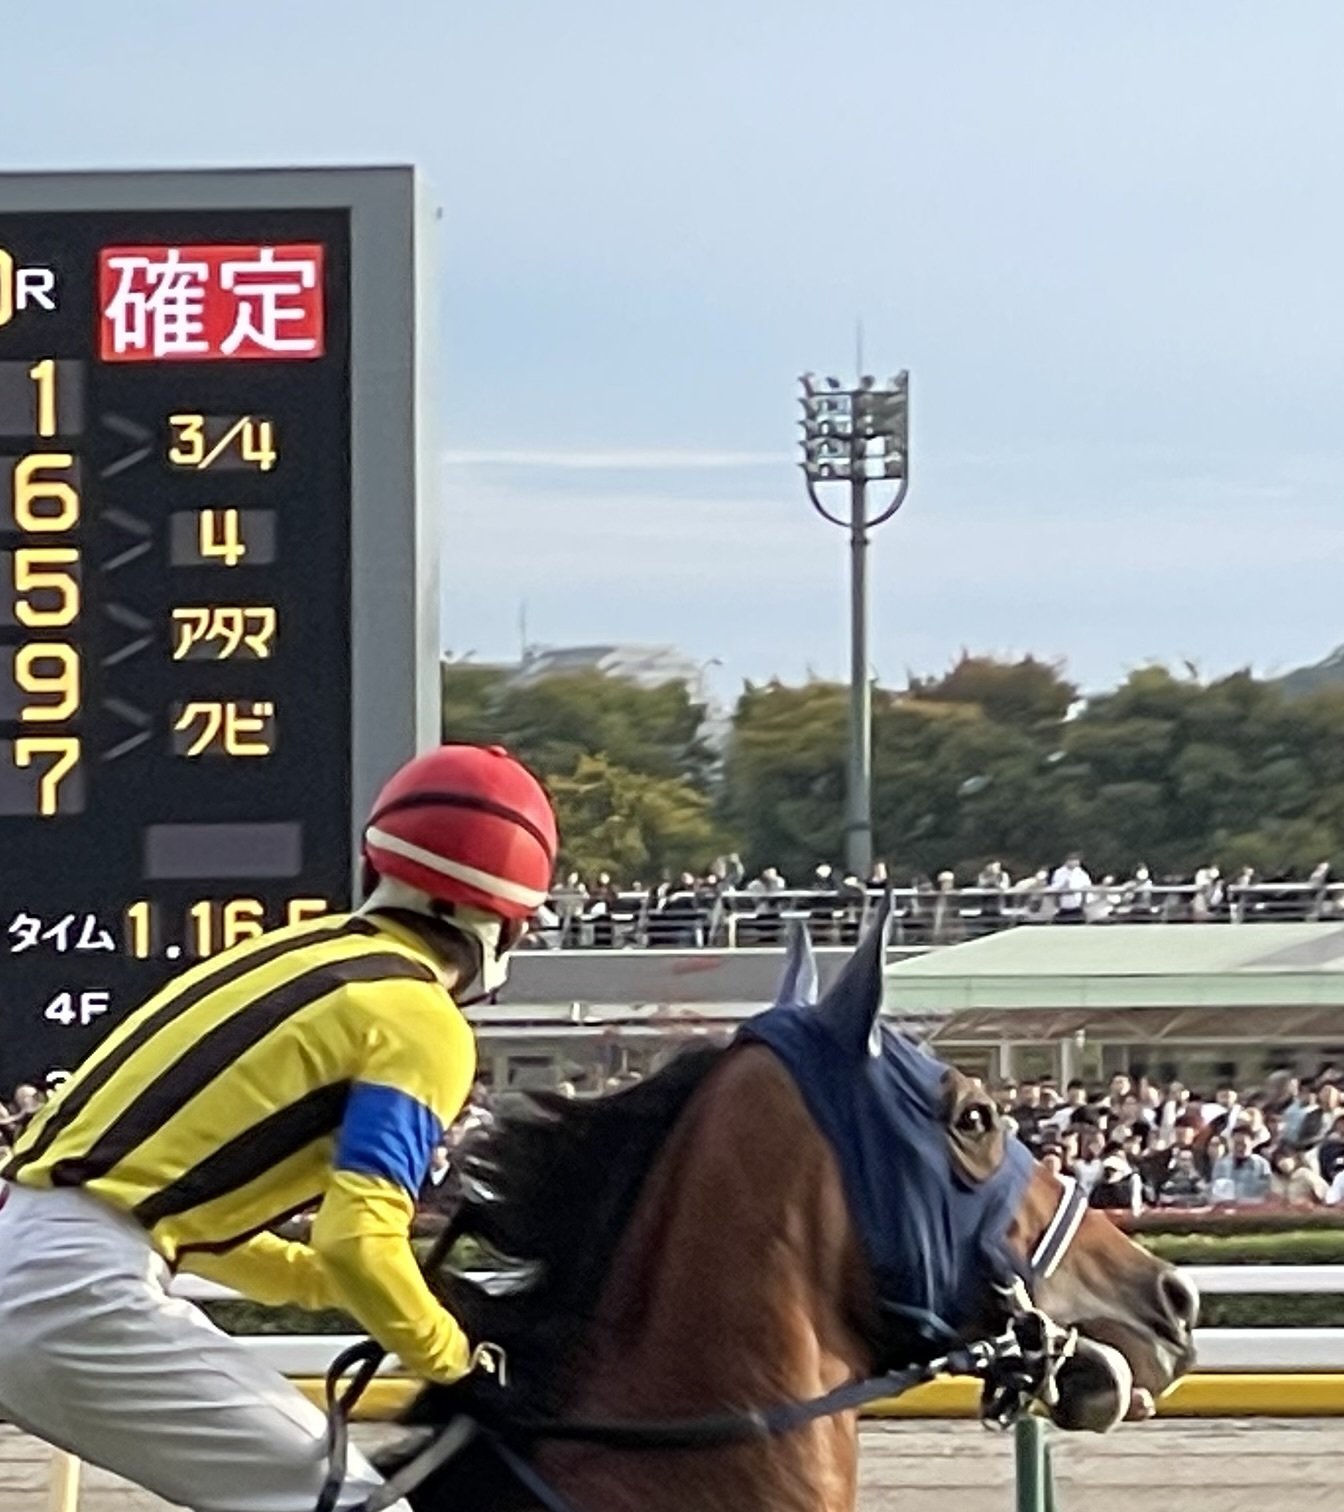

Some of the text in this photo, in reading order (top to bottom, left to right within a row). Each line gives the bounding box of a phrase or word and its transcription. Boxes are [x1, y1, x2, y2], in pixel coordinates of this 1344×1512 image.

[104, 248, 317, 358] 確定
[169, 414, 276, 471] 3/4
[14, 454, 80, 532] 6
[200, 509, 246, 566] 4
[14, 548, 80, 627] 5
[172, 607, 276, 660] アタマ
[14, 643, 80, 722] 9
[174, 702, 274, 756] クビ
[14, 737, 80, 816] 7
[7, 913, 116, 952] タイム
[44, 992, 110, 1025] 4F
